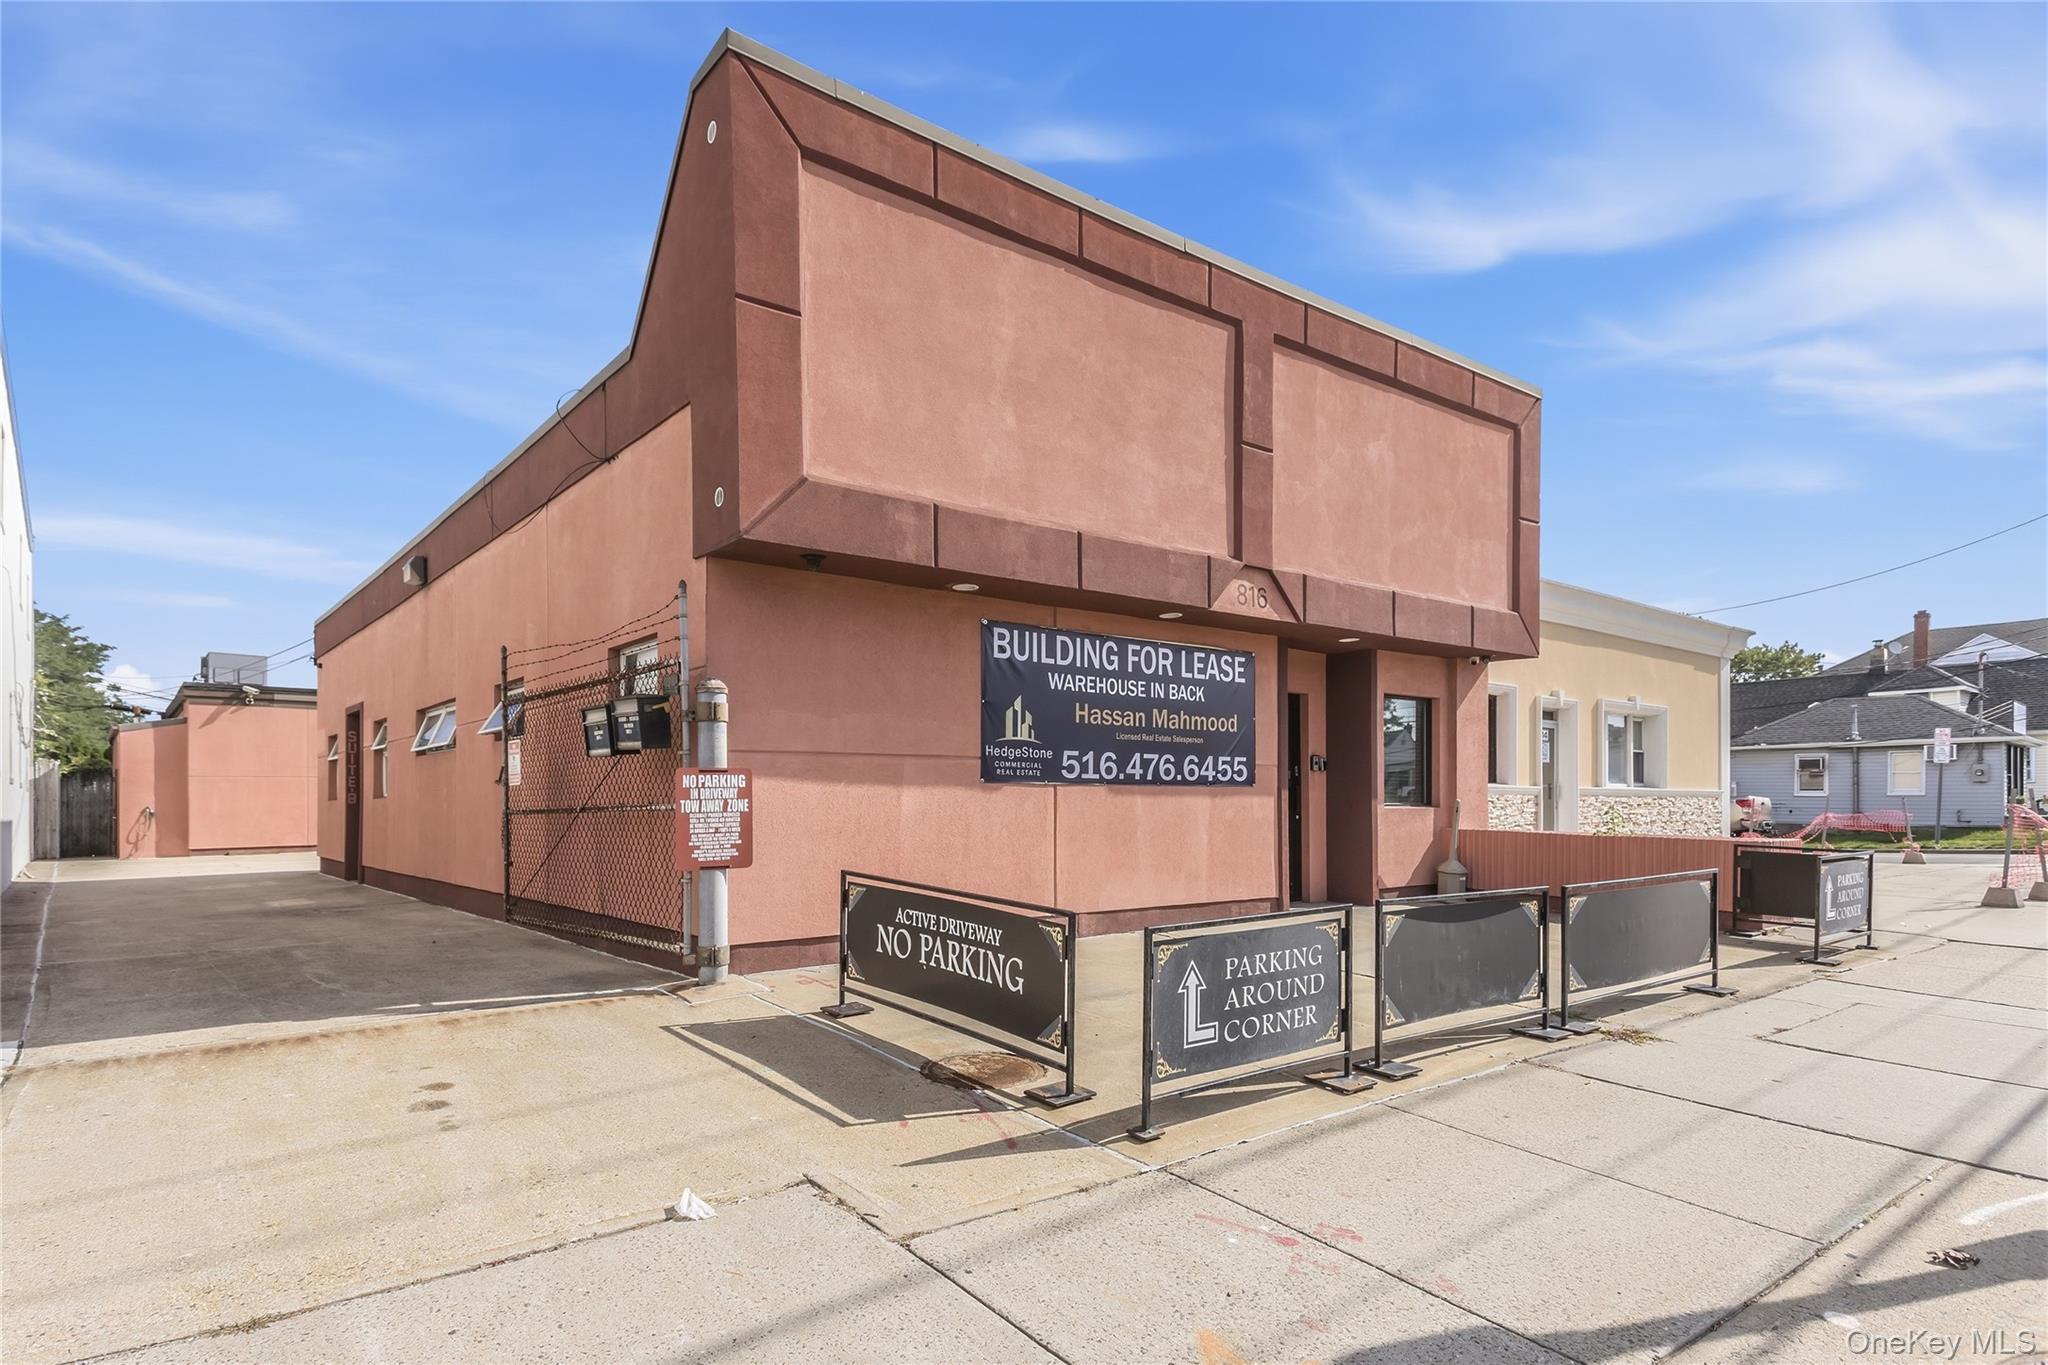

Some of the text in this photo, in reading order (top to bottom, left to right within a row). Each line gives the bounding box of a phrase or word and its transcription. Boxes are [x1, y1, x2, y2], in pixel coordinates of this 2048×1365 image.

[1237, 583, 1268, 609] 816
[992, 626, 1246, 684] BUILDING FOR LEASE
[1047, 671, 1205, 703] WAREHOUSE IN BACK
[1075, 702, 1238, 733] Hassan Mahmood
[1115, 731, 1204, 745] Licensed Real Estate Salesperson
[985, 744, 1053, 760] HedgeStone
[994, 760, 1042, 769] COMMERCIAL
[996, 768, 1041, 777] REAL ESTATE
[1060, 750, 1248, 782] 516.476.6455
[682, 774, 746, 789] NO PARKING
[690, 788, 739, 800] IN DRIVEWAY
[680, 798, 749, 813] TOW AWAY ZONE
[1837, 871, 1864, 888] PARKING
[1836, 887, 1864, 903] AROUND
[1836, 903, 1862, 920] CORNER
[895, 907, 1003, 947] ACTIVE DRIVEWAY
[875, 923, 1025, 995] NO PARKING
[1224, 944, 1324, 980] PARKING
[1223, 973, 1325, 1011] AROUND
[1223, 1004, 1318, 1043] CORNER
